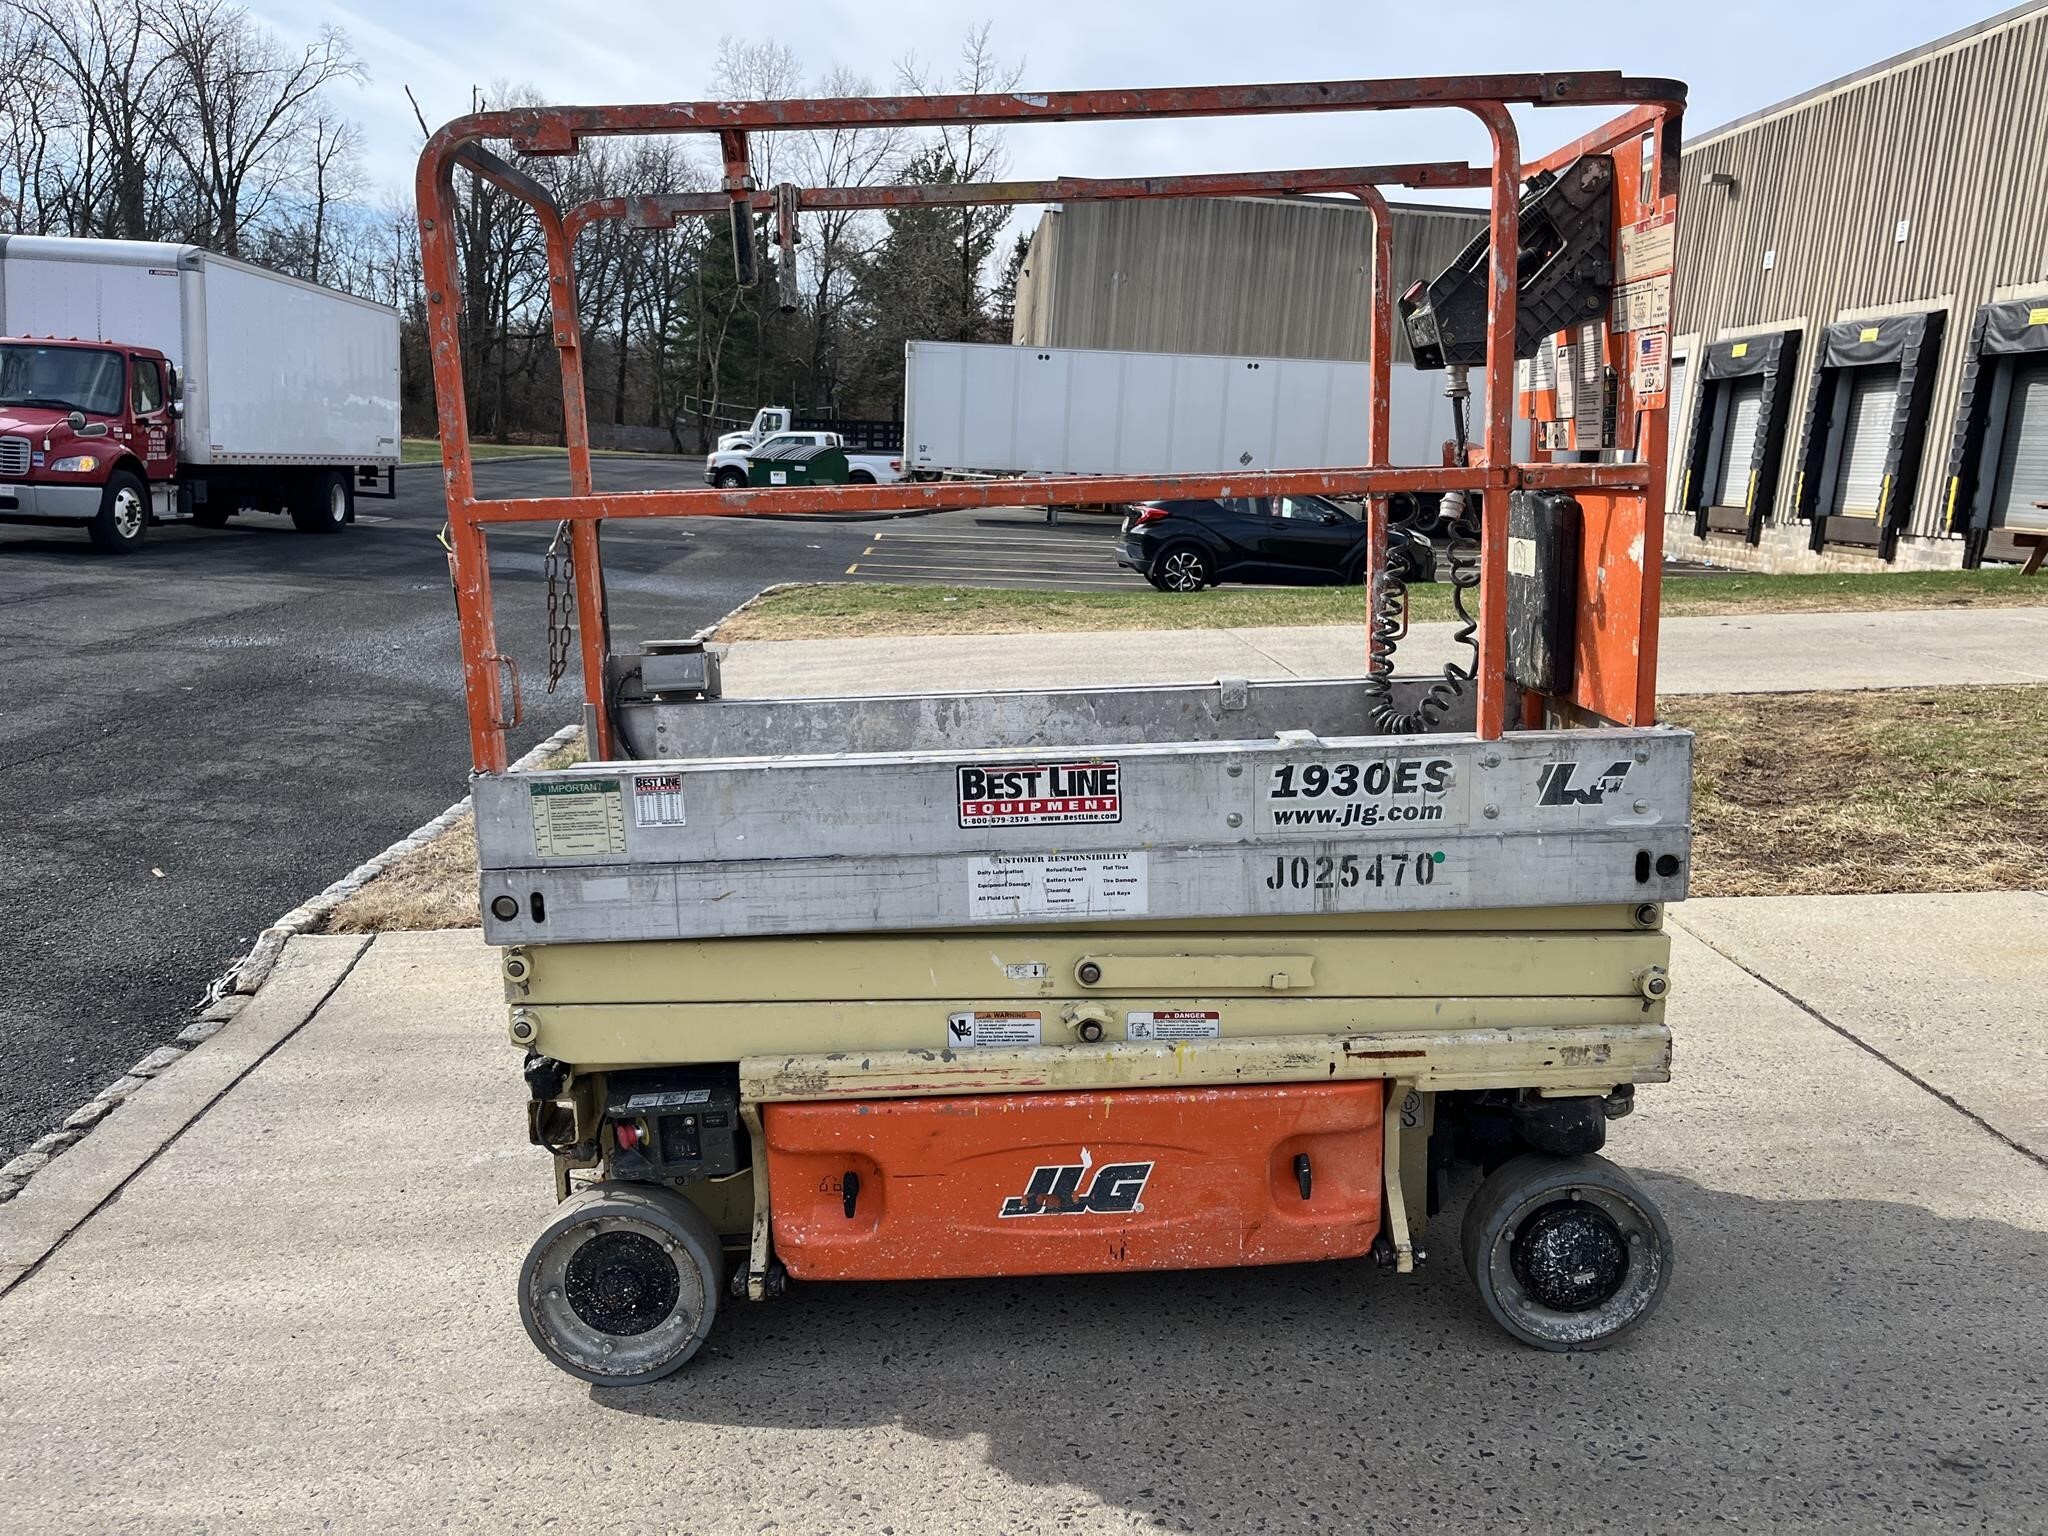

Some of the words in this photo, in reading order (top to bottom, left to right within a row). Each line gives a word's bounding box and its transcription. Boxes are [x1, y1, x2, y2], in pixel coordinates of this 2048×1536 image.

[635, 777, 658, 788] BEST
[660, 776, 681, 787] LINE
[962, 769, 1042, 801] BEST
[1049, 767, 1117, 798] LINE
[1271, 760, 1453, 798] 1930ES
[548, 782, 602, 793] IMPORTANT
[966, 799, 1114, 814] EQUIPMENT
[963, 815, 1029, 825] 1-800-679-2378
[1040, 813, 1118, 823] www.BestLine.com
[1274, 804, 1443, 827] www.jlg.com
[997, 856, 1045, 864] USTOMER
[1048, 852, 1128, 862] RESPONSIBILITY
[1266, 852, 1435, 890] J025470
